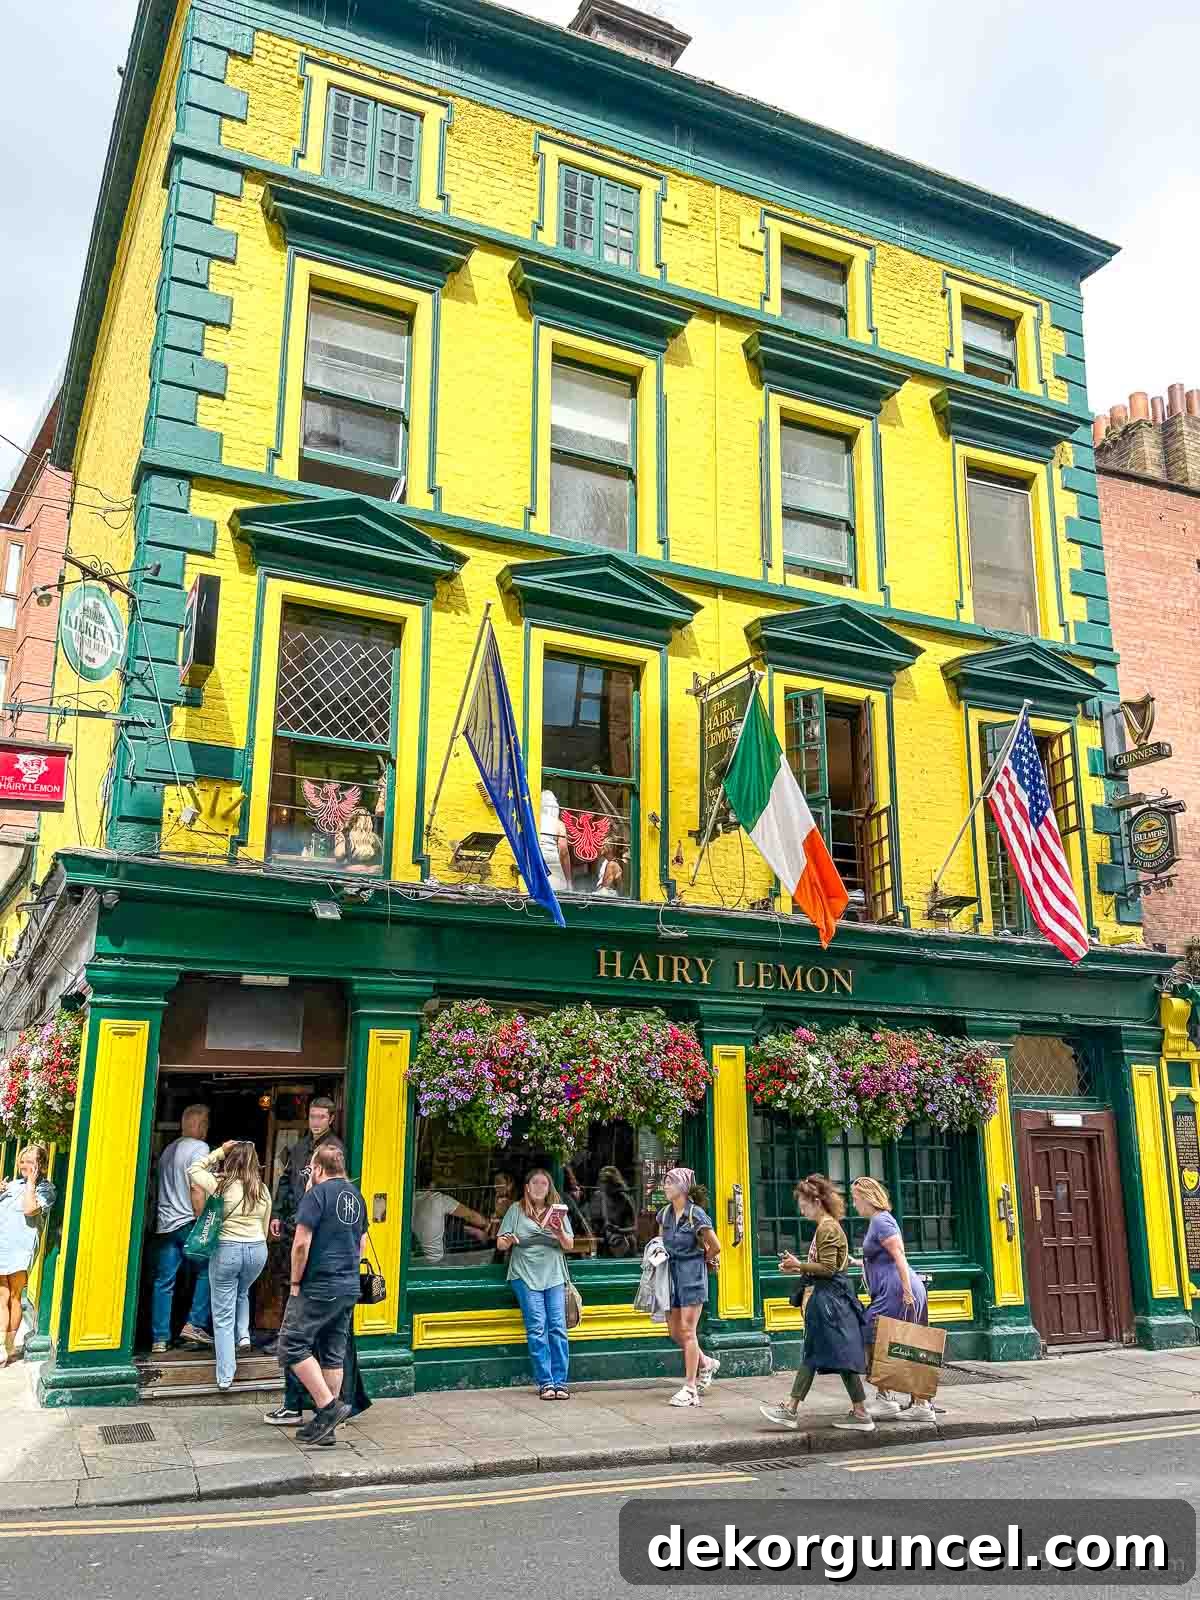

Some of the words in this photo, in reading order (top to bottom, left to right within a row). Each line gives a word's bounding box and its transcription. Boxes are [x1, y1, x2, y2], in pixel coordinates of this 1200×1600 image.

[712, 698, 727, 712] THE
[705, 705, 737, 732] HAIRY
[1116, 746, 1159, 765] GUINNESS
[0, 782, 27, 790] HAIRY
[29, 783, 60, 793] LEMON
[1134, 828, 1167, 842] BULMERS
[1133, 857, 1143, 867] ON
[1142, 849, 1172, 868] DRAUGHT
[598, 949, 713, 985] HAIRY
[735, 961, 853, 994] LEMON
